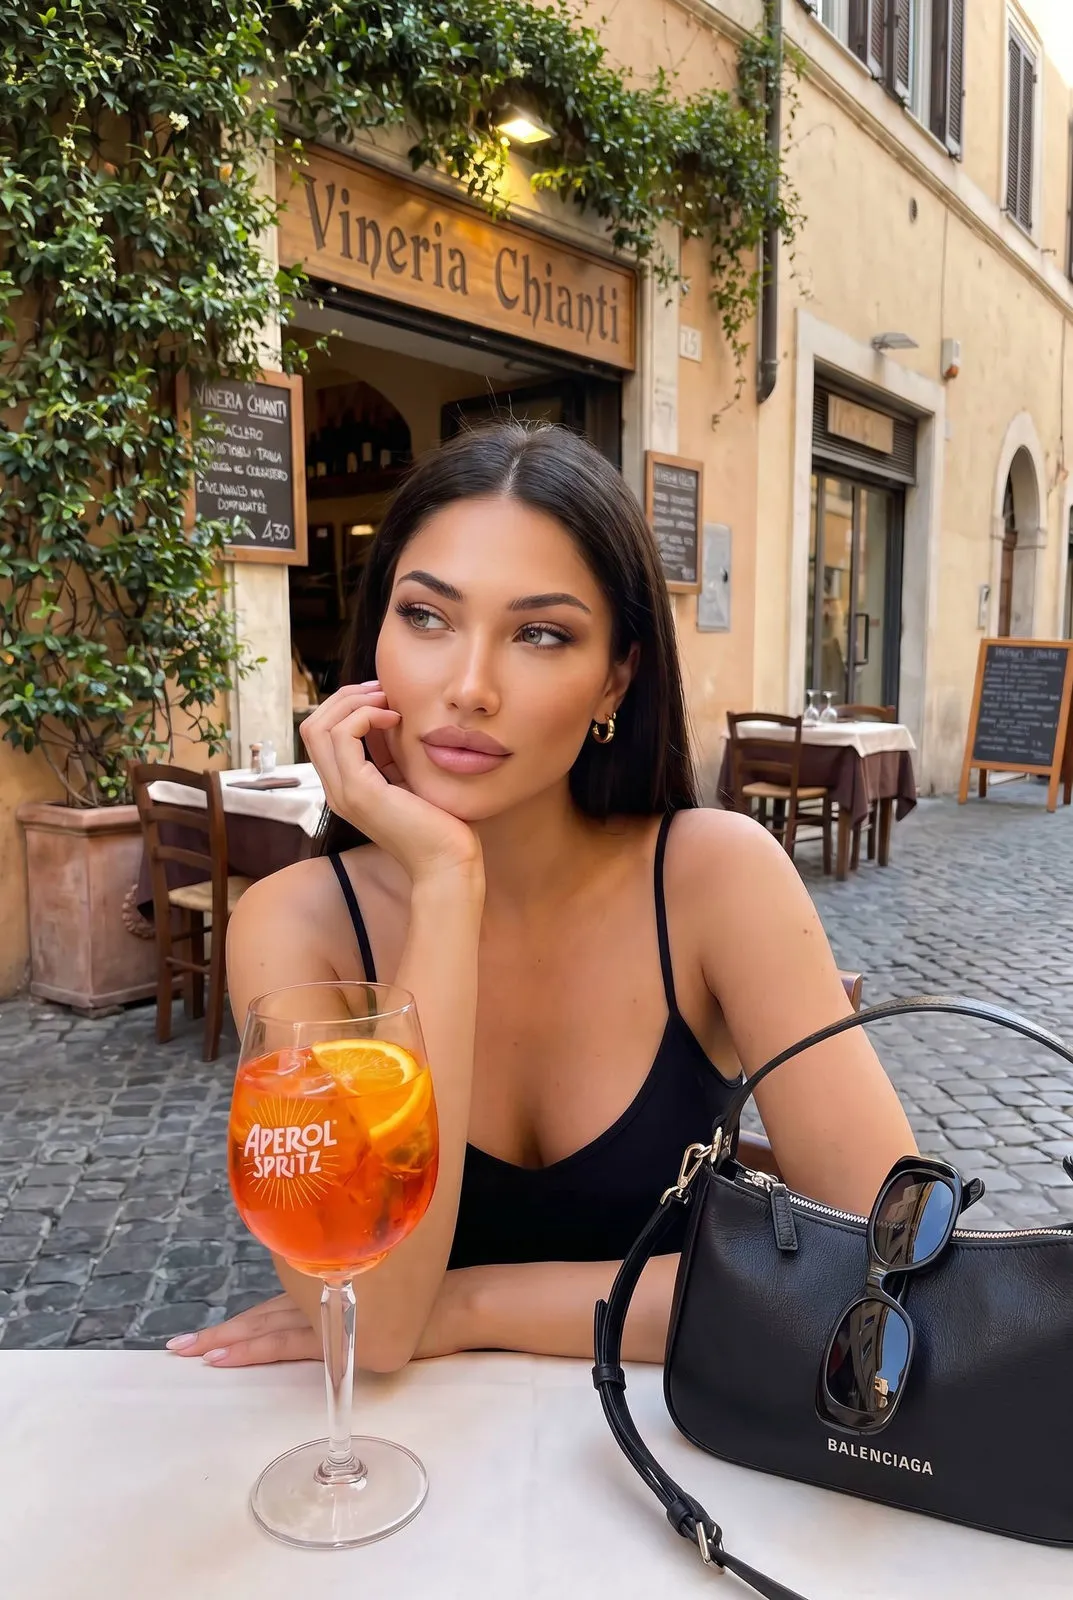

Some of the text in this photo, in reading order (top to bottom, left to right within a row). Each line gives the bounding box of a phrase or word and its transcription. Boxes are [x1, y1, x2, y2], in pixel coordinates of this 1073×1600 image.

[301, 172, 620, 345] Vineria Chianti
[195, 382, 287, 418] VINERIA CHIANTI
[243, 1120, 338, 1157] APEROL
[827, 1437, 934, 1476] BALENCIAGA
